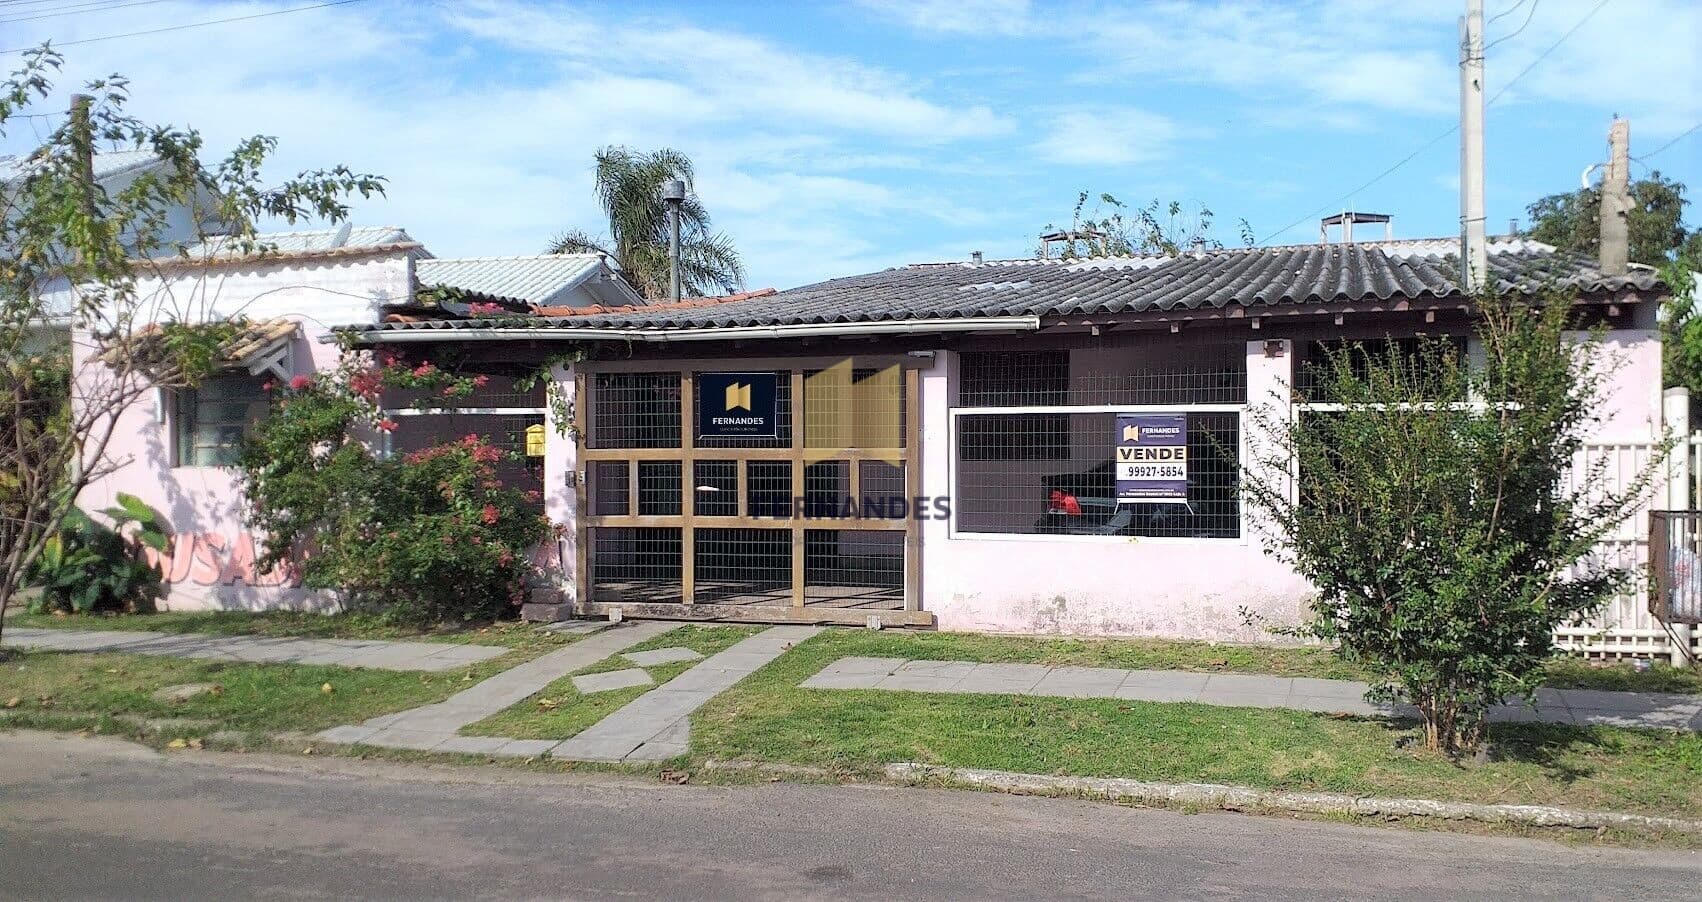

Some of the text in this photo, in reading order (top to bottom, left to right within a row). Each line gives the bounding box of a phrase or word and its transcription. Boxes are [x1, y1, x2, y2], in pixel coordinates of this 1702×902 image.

[712, 417, 764, 425] FERNANDES
[1119, 448, 1184, 460] VENDE
[1128, 466, 1184, 477] 99927-5854
